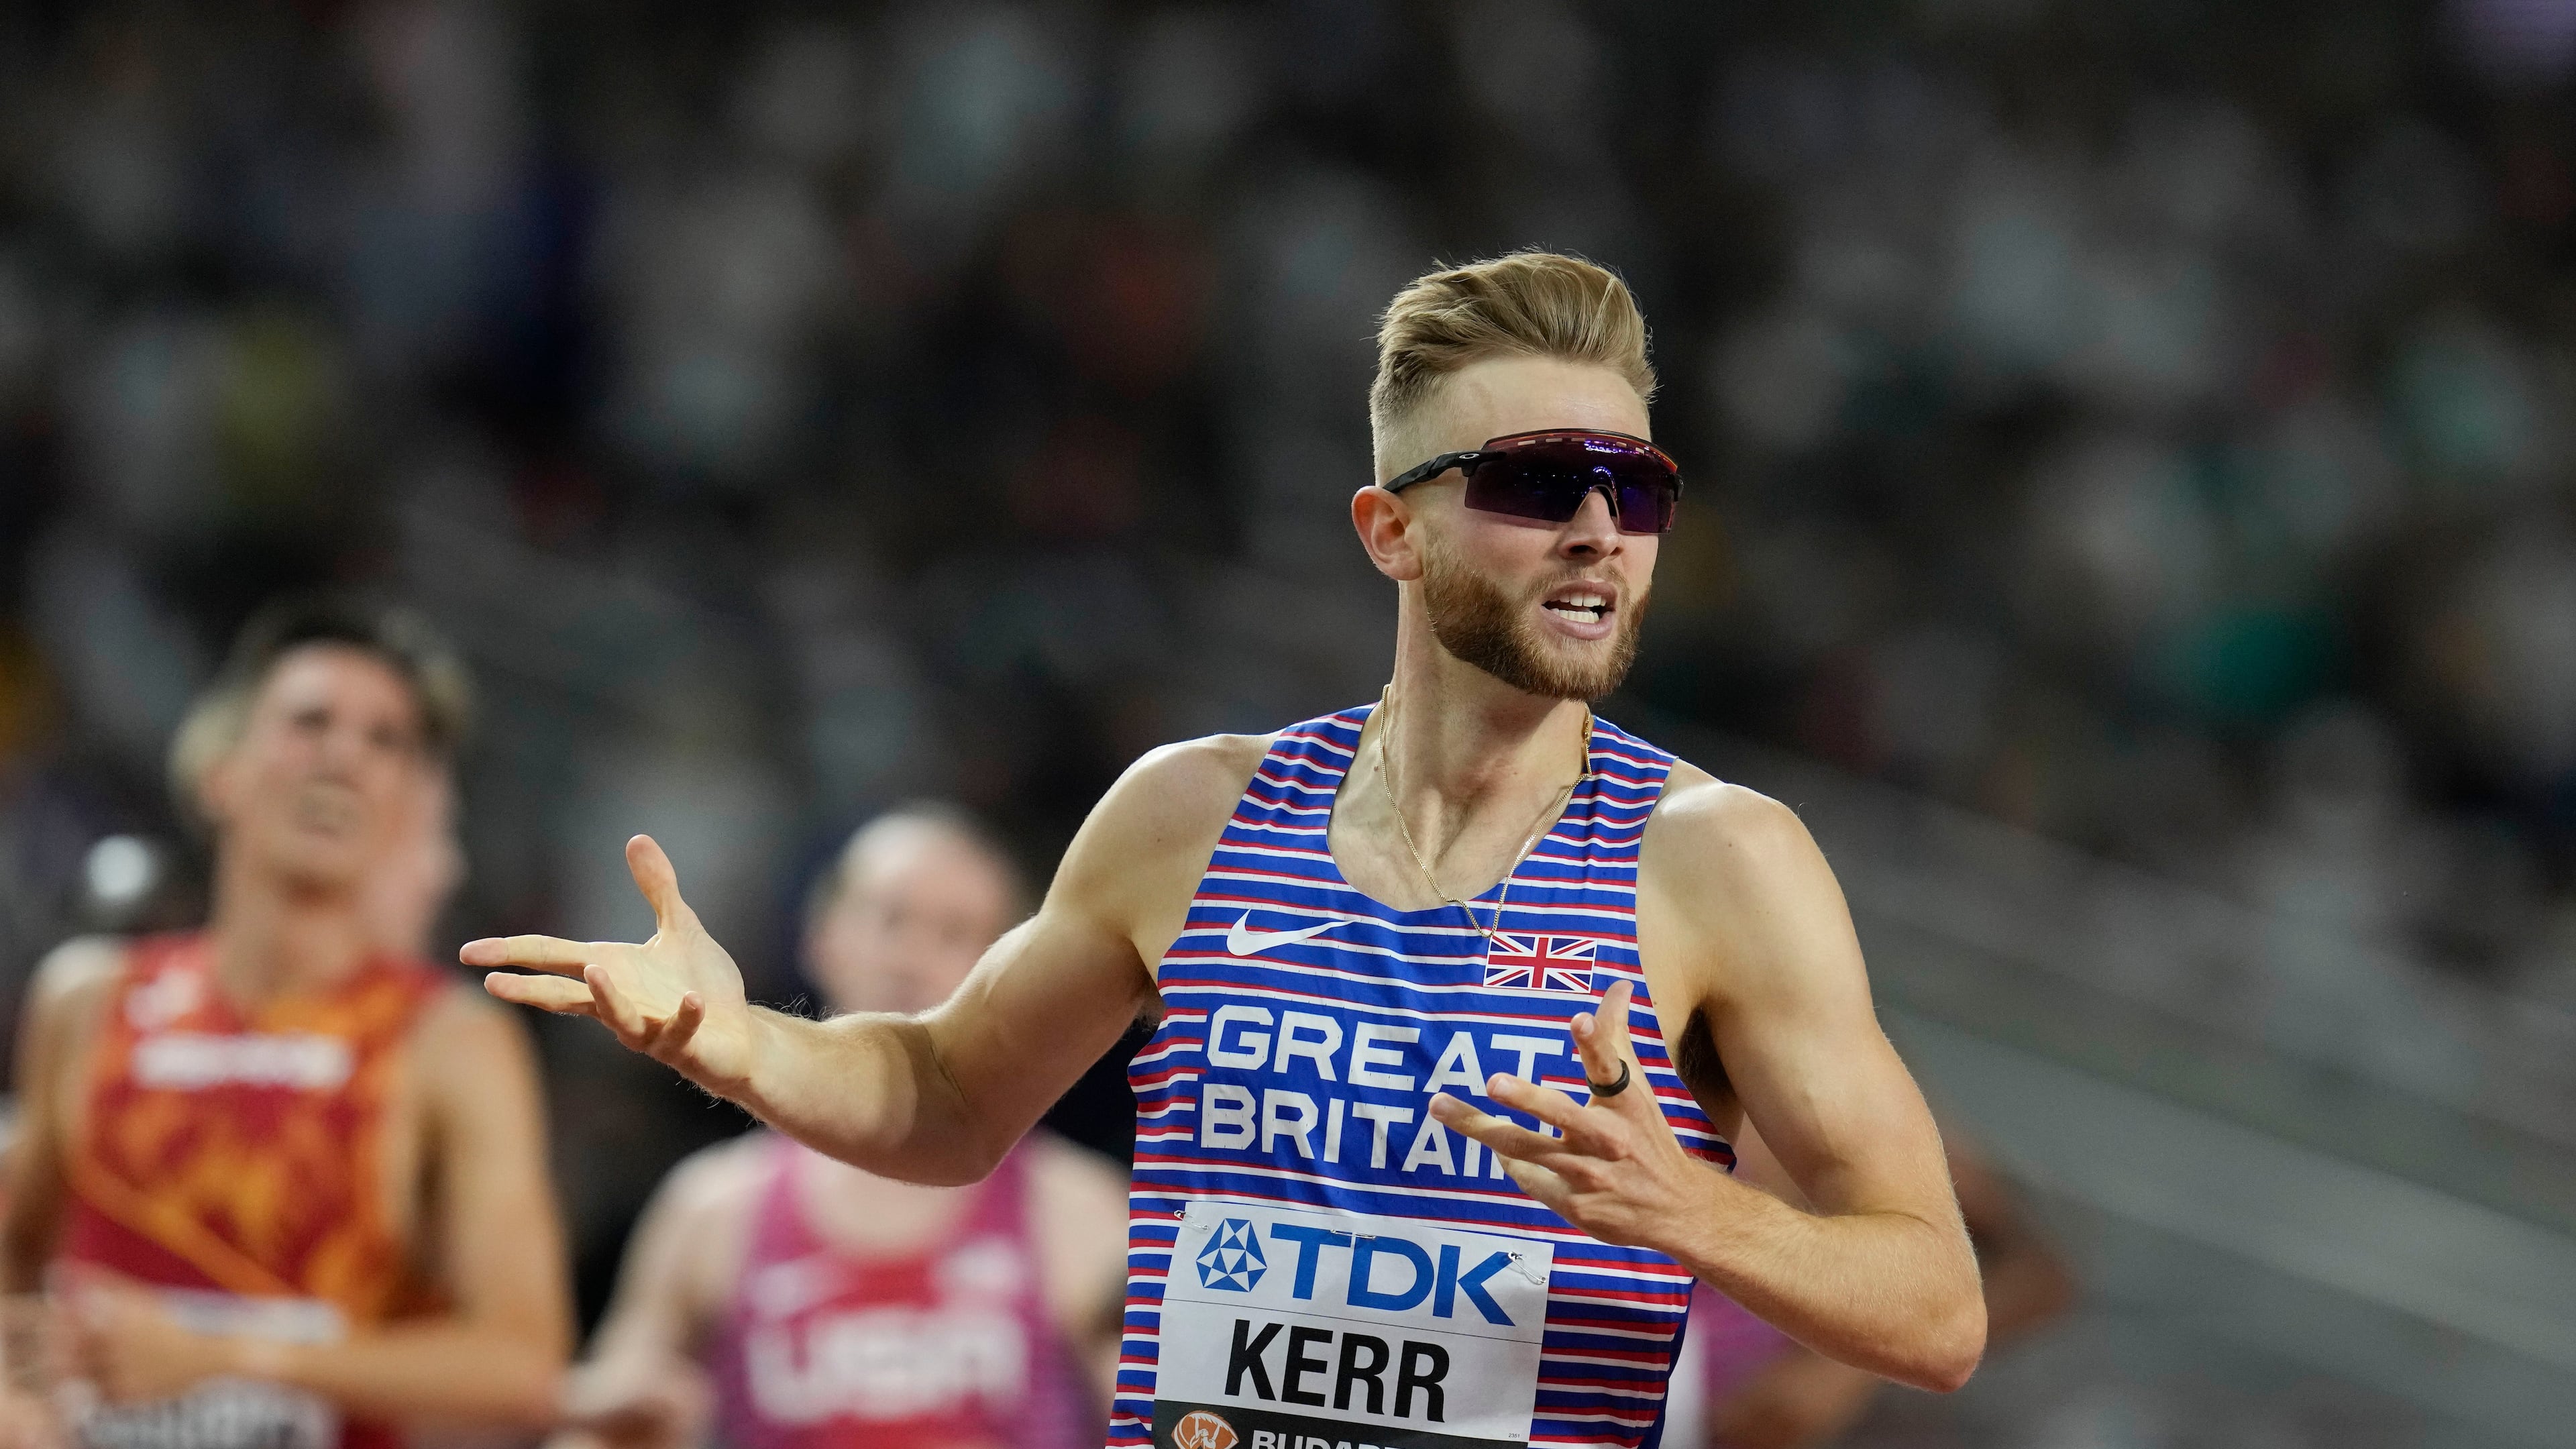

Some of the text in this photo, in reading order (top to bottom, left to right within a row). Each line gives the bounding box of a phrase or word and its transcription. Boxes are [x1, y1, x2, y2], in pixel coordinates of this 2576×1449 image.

[1207, 1005, 1564, 1096] GREAT
[1271, 1222, 1515, 1326] TDK
[1225, 1320, 1450, 1423] KERR
